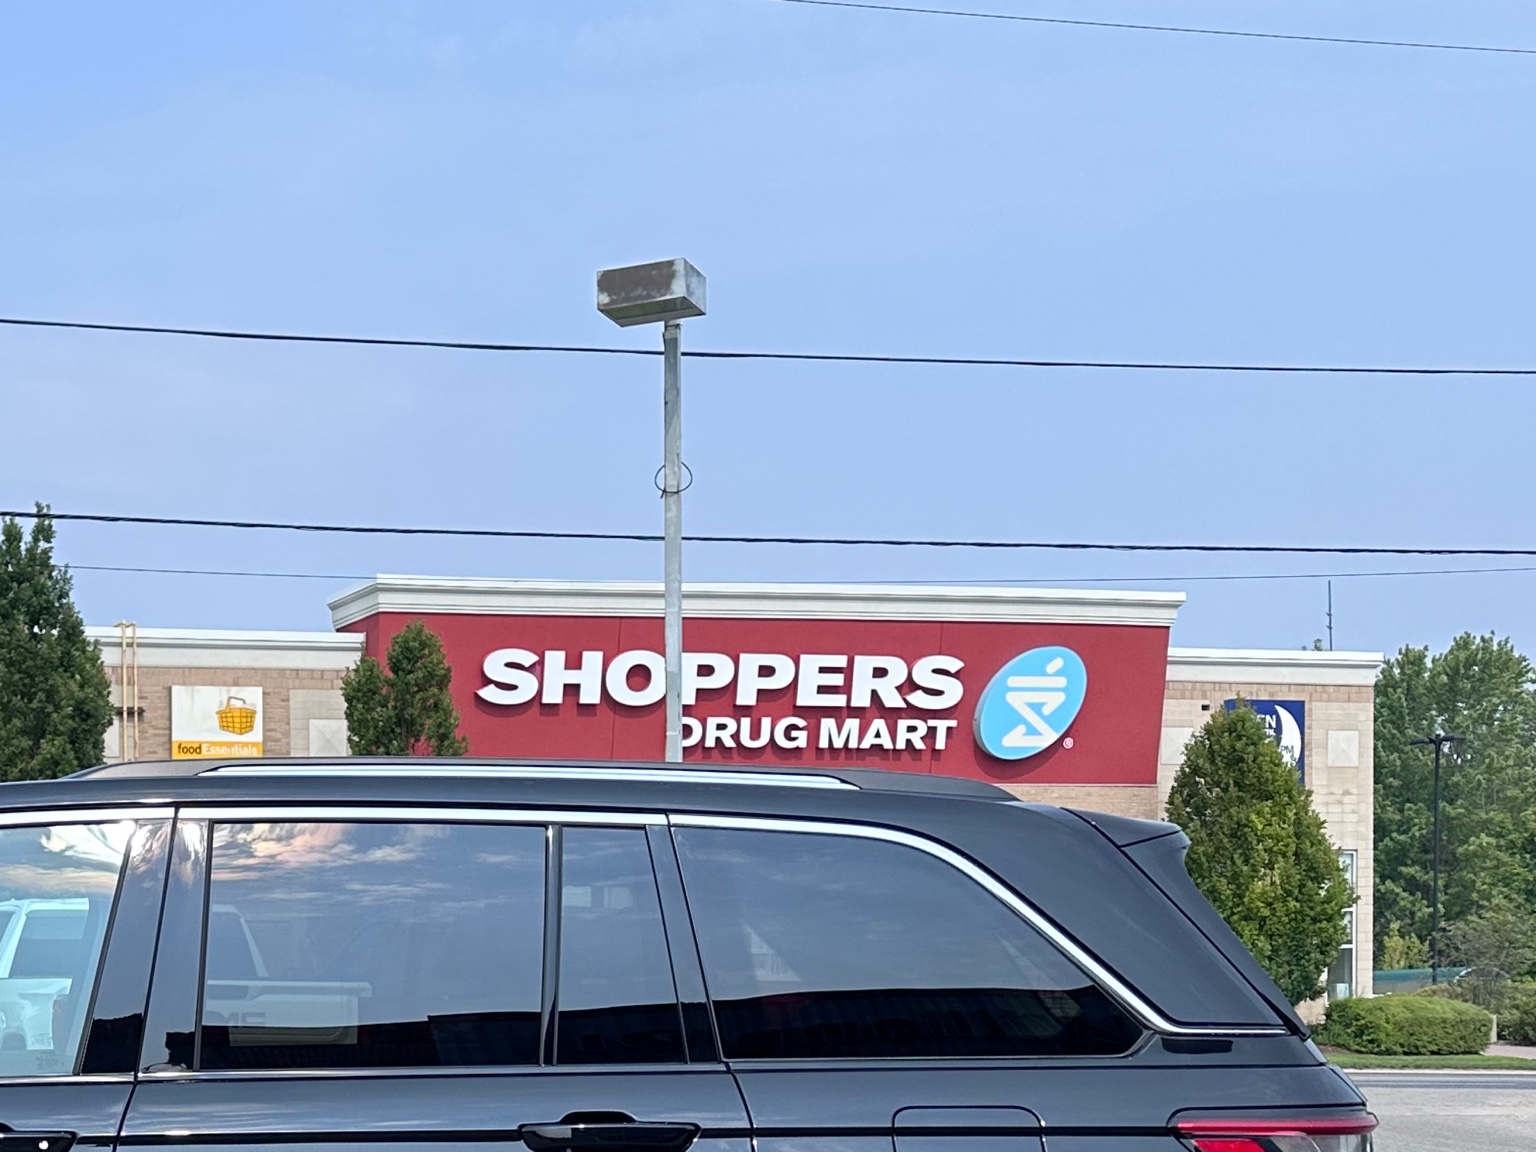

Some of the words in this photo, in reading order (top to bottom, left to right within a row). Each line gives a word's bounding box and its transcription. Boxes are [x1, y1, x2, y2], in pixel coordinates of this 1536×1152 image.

[474, 648, 965, 710] SHOPPERS
[177, 743, 202, 755] food
[204, 743, 258, 756] Essentials
[681, 716, 808, 749] DRUG
[819, 718, 958, 750] MART
